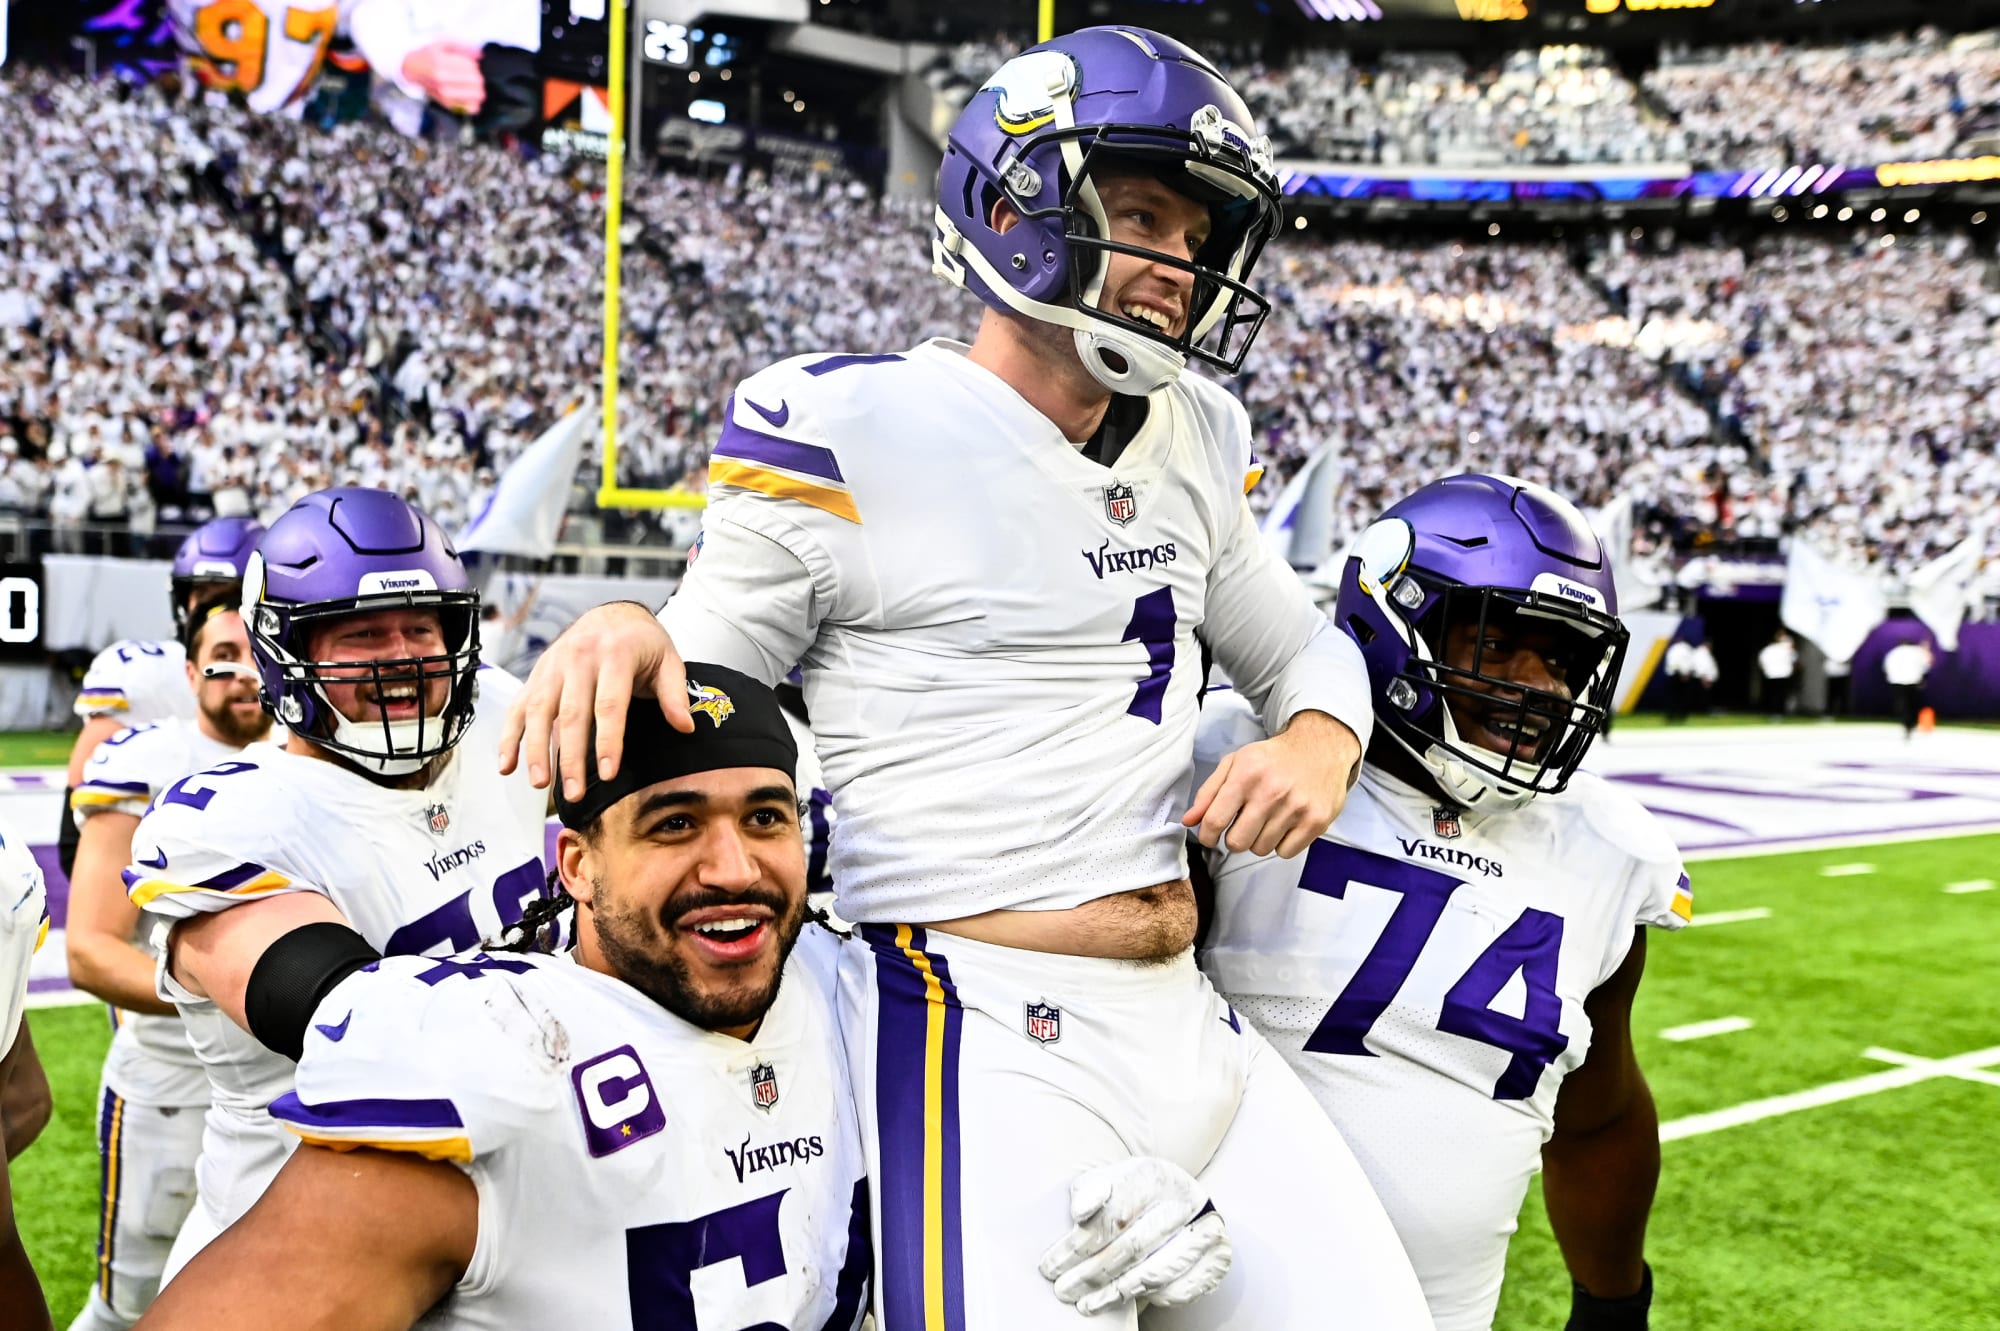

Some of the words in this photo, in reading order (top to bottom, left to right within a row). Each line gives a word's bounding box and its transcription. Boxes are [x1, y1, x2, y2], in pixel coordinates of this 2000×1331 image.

[195, 0, 338, 108] 97
[1111, 499, 1133, 518] NFL
[0, 577, 38, 642] 0
[1121, 584, 1177, 726] 1
[1436, 820, 1459, 835] NFL
[1297, 837, 1569, 1101] 74
[1030, 1017, 1057, 1039] NFL
[580, 1053, 650, 1130] C
[755, 1082, 777, 1103] NFL
